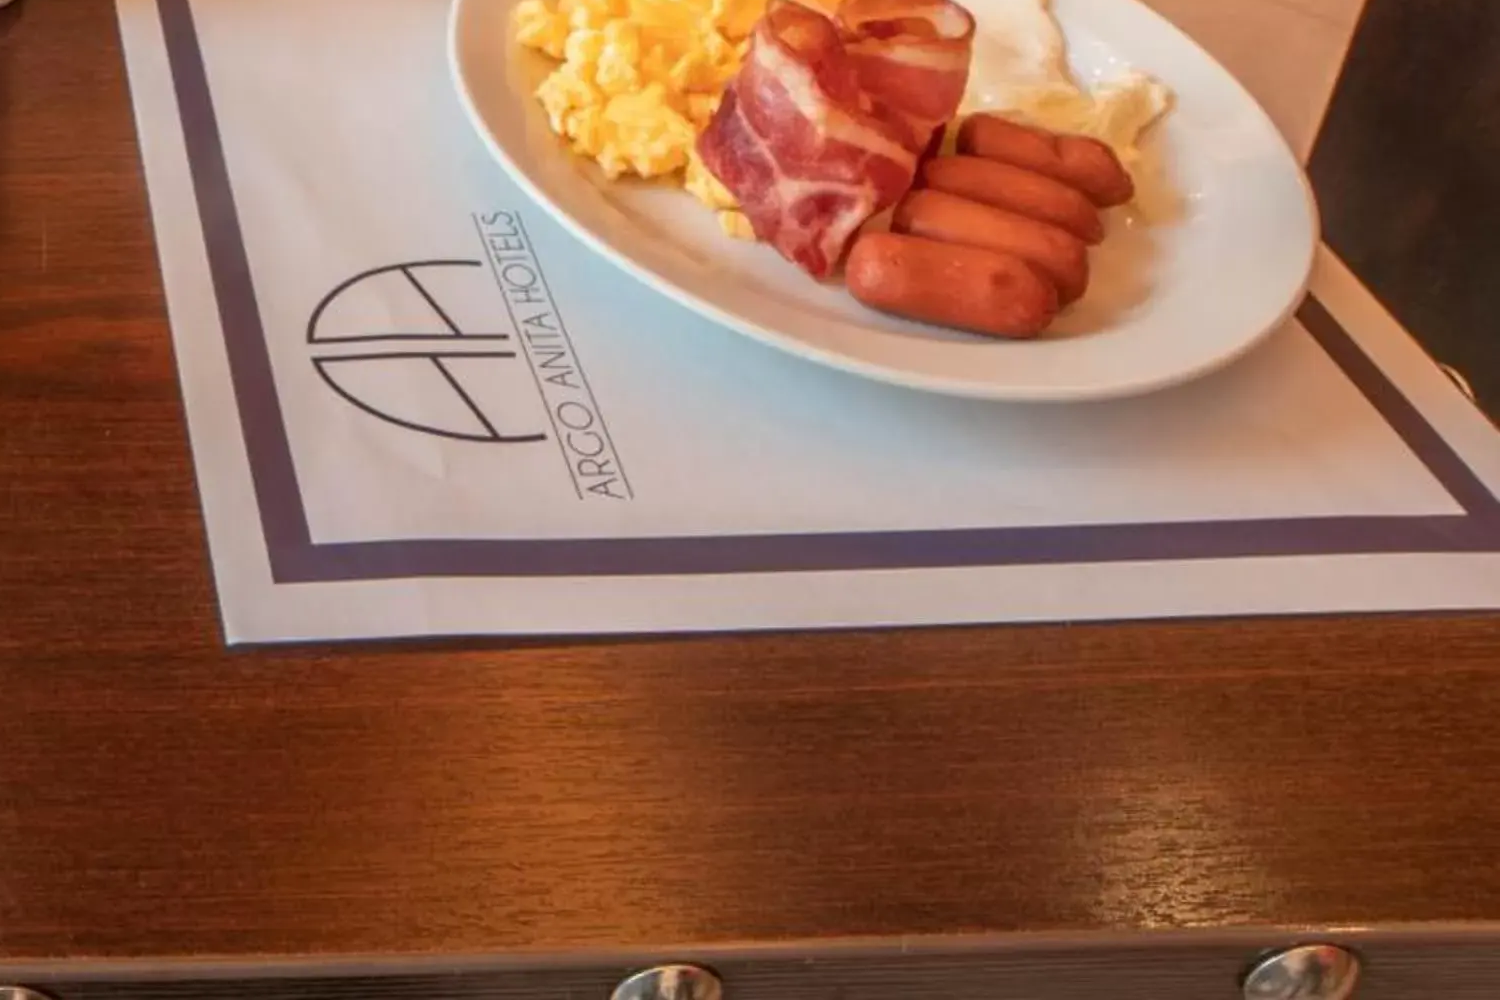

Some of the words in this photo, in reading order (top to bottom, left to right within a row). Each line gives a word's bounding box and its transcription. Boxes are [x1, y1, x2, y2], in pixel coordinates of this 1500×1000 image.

[481, 209, 544, 304] HOTELS
[522, 311, 581, 390] ANITA
[558, 402, 623, 500] ARGO
